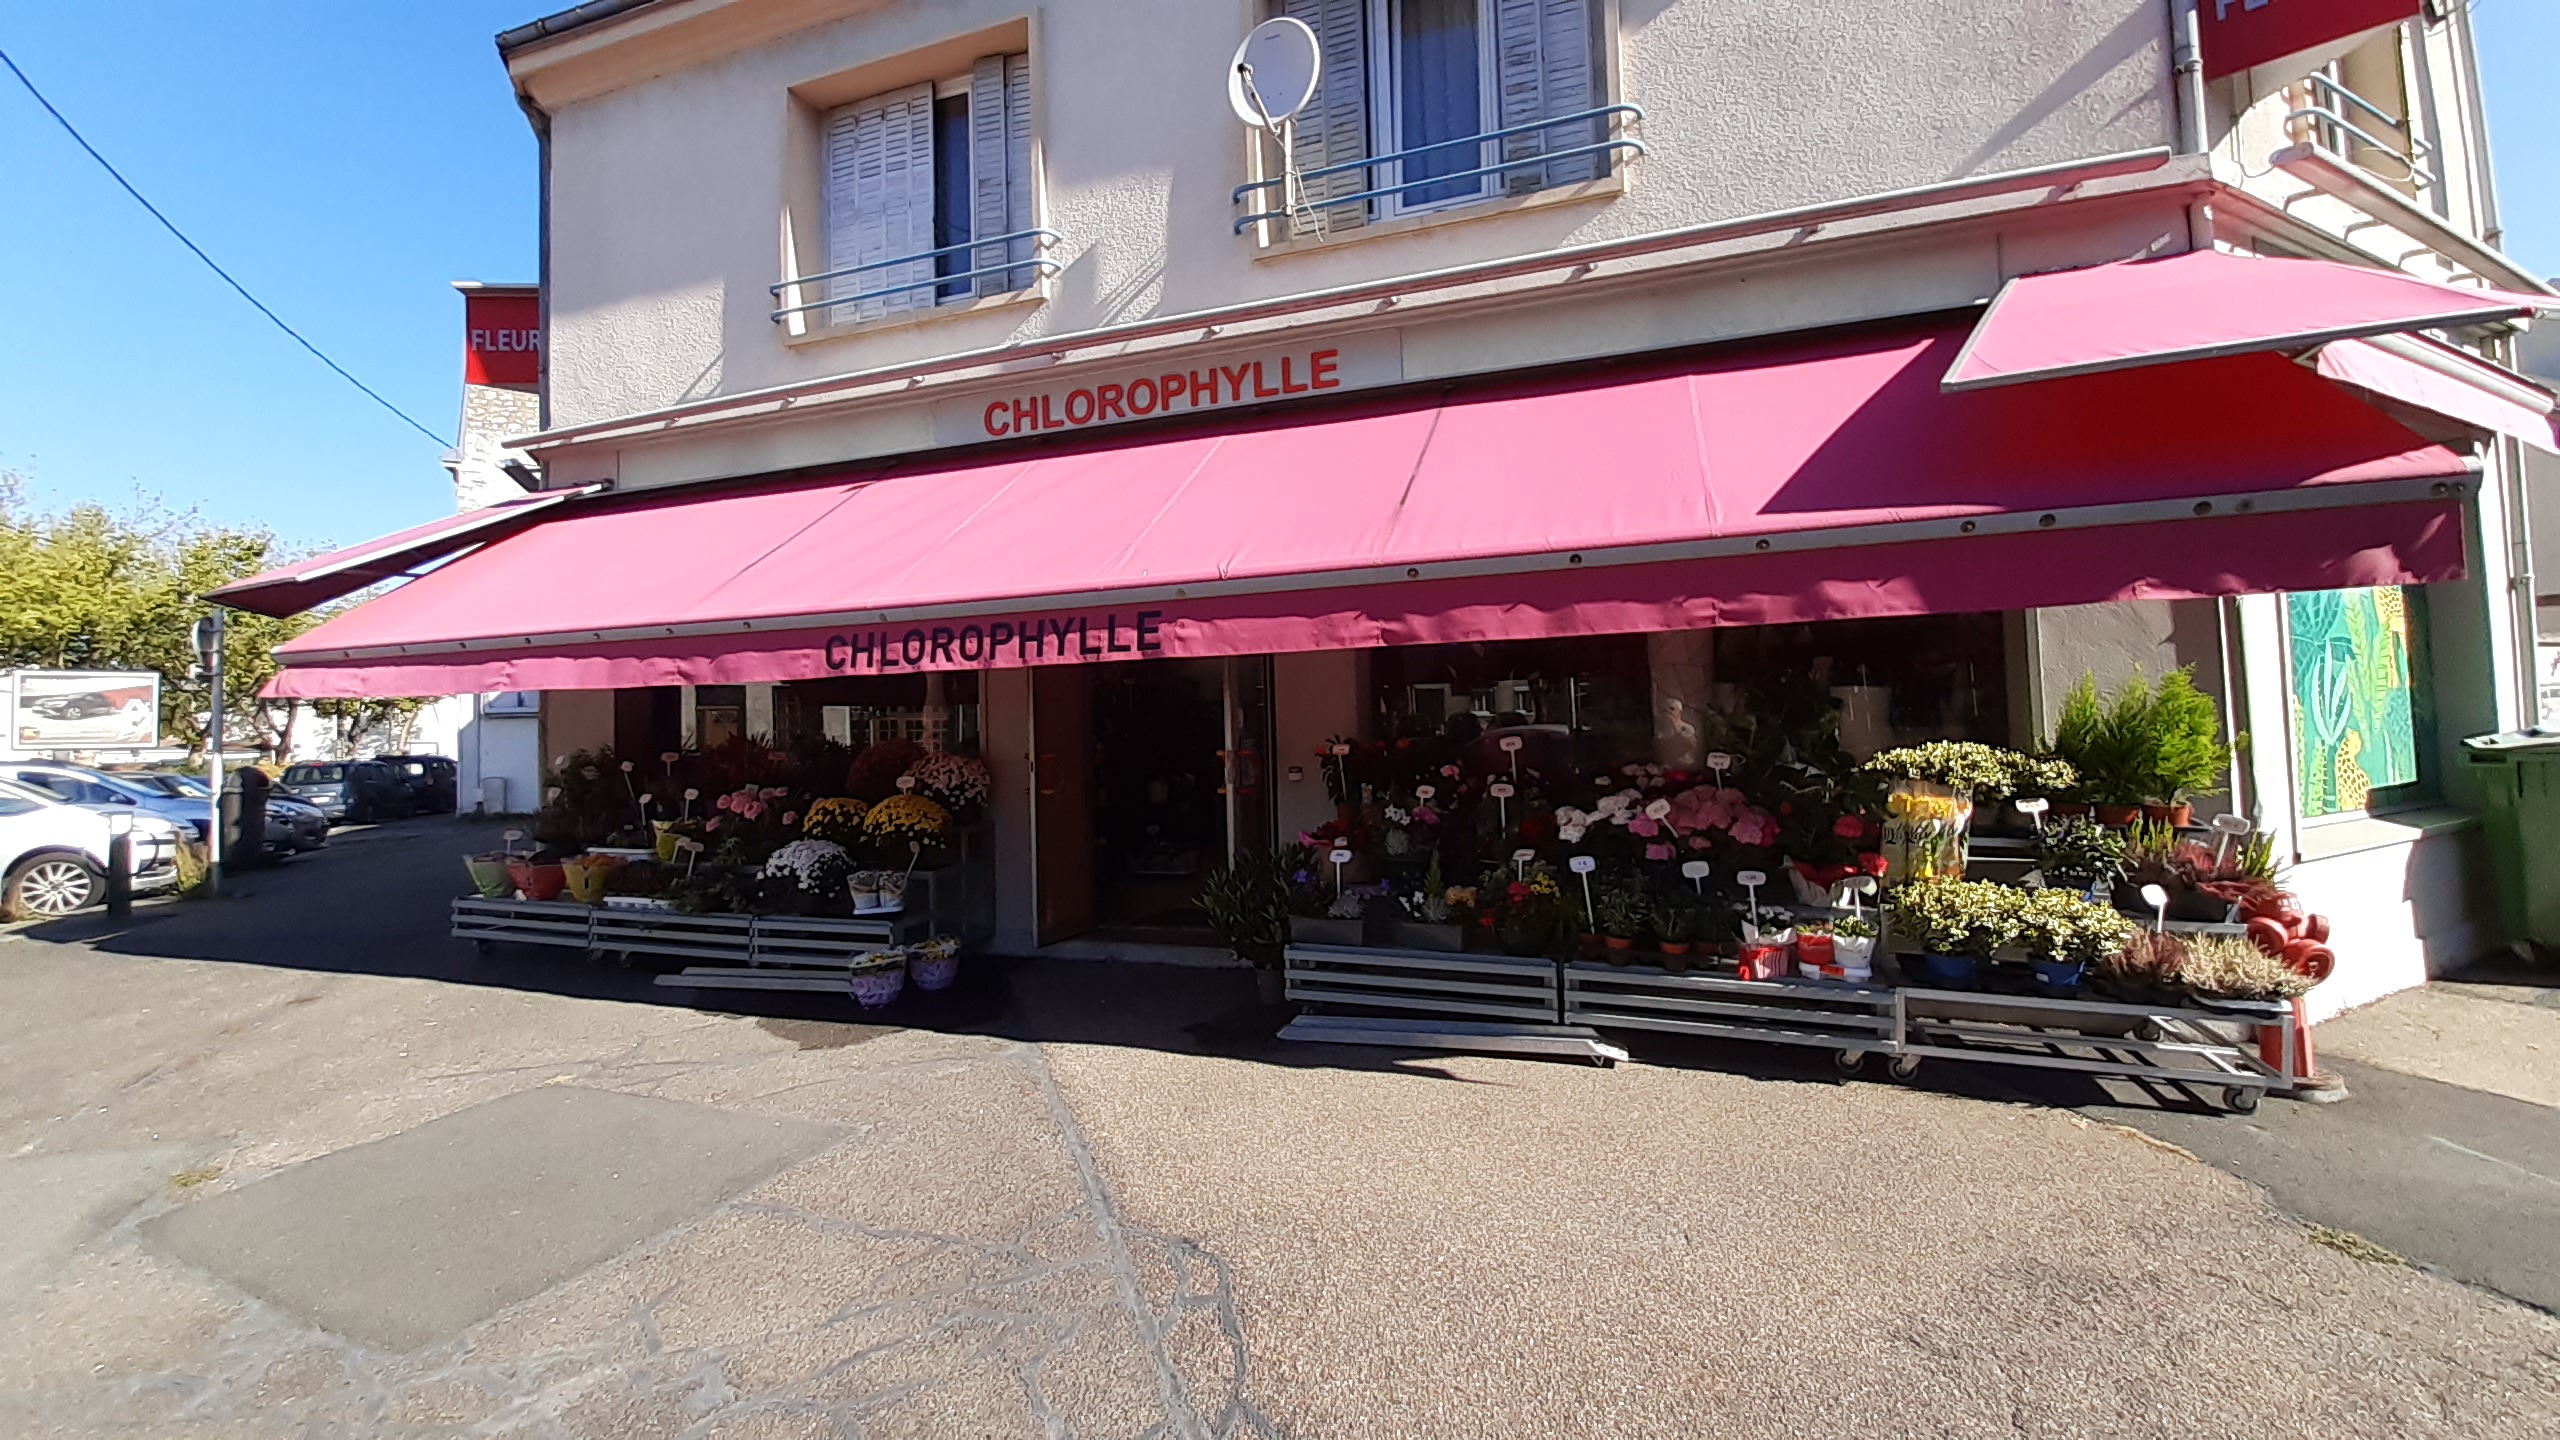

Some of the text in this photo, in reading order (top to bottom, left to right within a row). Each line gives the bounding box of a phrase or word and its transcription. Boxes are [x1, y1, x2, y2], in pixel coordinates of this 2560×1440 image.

[471, 329, 540, 352] FLEUR
[984, 349, 1340, 436] CHLOROPHYLLE
[825, 610, 1162, 670] CHLOROPHYLLE
